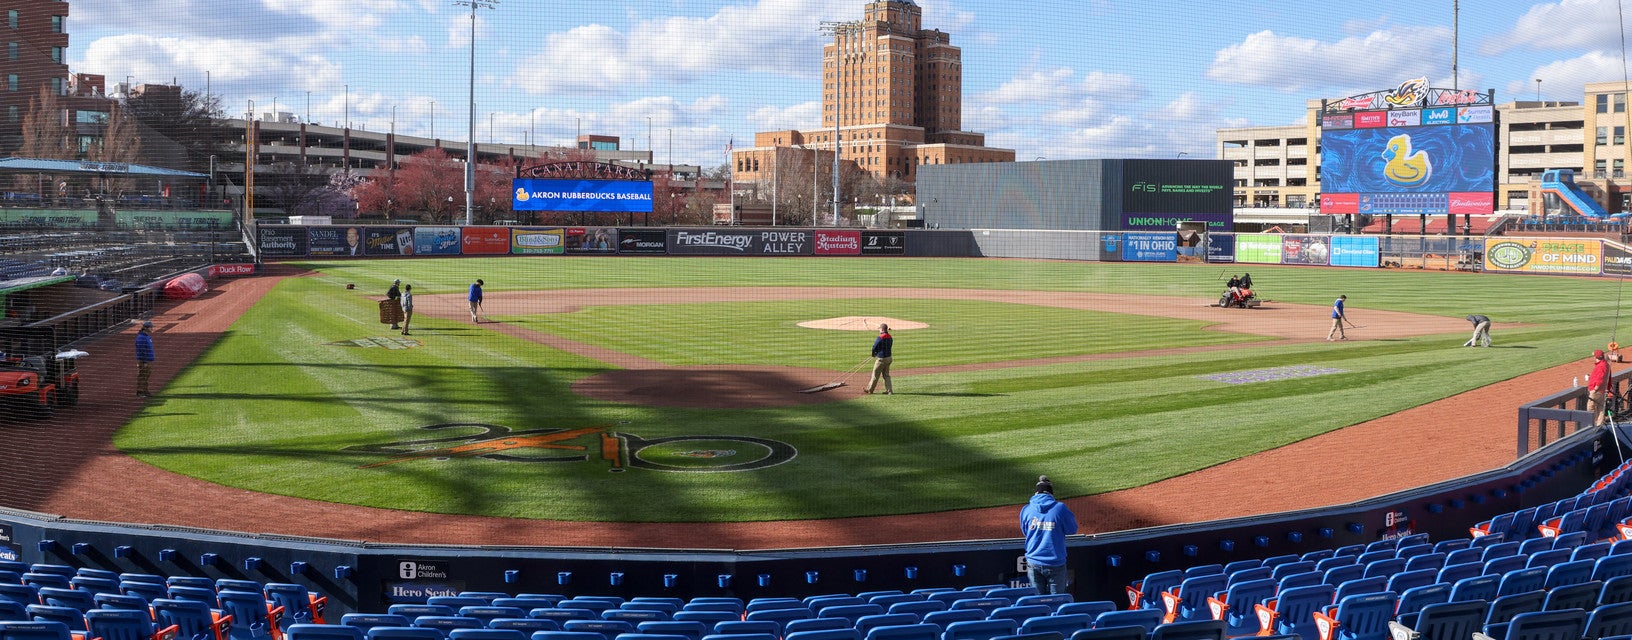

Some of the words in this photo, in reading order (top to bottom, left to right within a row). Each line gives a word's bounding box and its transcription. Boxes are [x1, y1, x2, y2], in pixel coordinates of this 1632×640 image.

[1390, 111, 1418, 119] KeyBank
[531, 162, 584, 177] CANAL
[594, 162, 635, 178] PARK
[531, 191, 561, 199] AKRON
[562, 192, 615, 200] RUBBERDUCKS
[616, 193, 652, 201] BASEBALL
[1451, 198, 1491, 208] Budweiser
[260, 228, 275, 236] Ohio
[761, 231, 806, 242] POWER
[676, 232, 753, 248] FirstEnergy
[819, 233, 857, 243] Stadium
[260, 241, 297, 250] Authority
[763, 243, 803, 253] ALLEY
[818, 241, 858, 250] Mustard
[1128, 240, 1139, 251] #1
[1140, 240, 1149, 250] IN
[1151, 240, 1175, 251] OHIO
[1542, 243, 1585, 252] PEACE
[1542, 253, 1560, 262] OF
[1562, 253, 1597, 263] MIND
[236, 265, 252, 273] Row
[0, 552, 16, 561] eats
[417, 563, 436, 571] Akron
[417, 570, 447, 579] Children's
[392, 586, 423, 598] Hero
[424, 587, 457, 598] Seats
